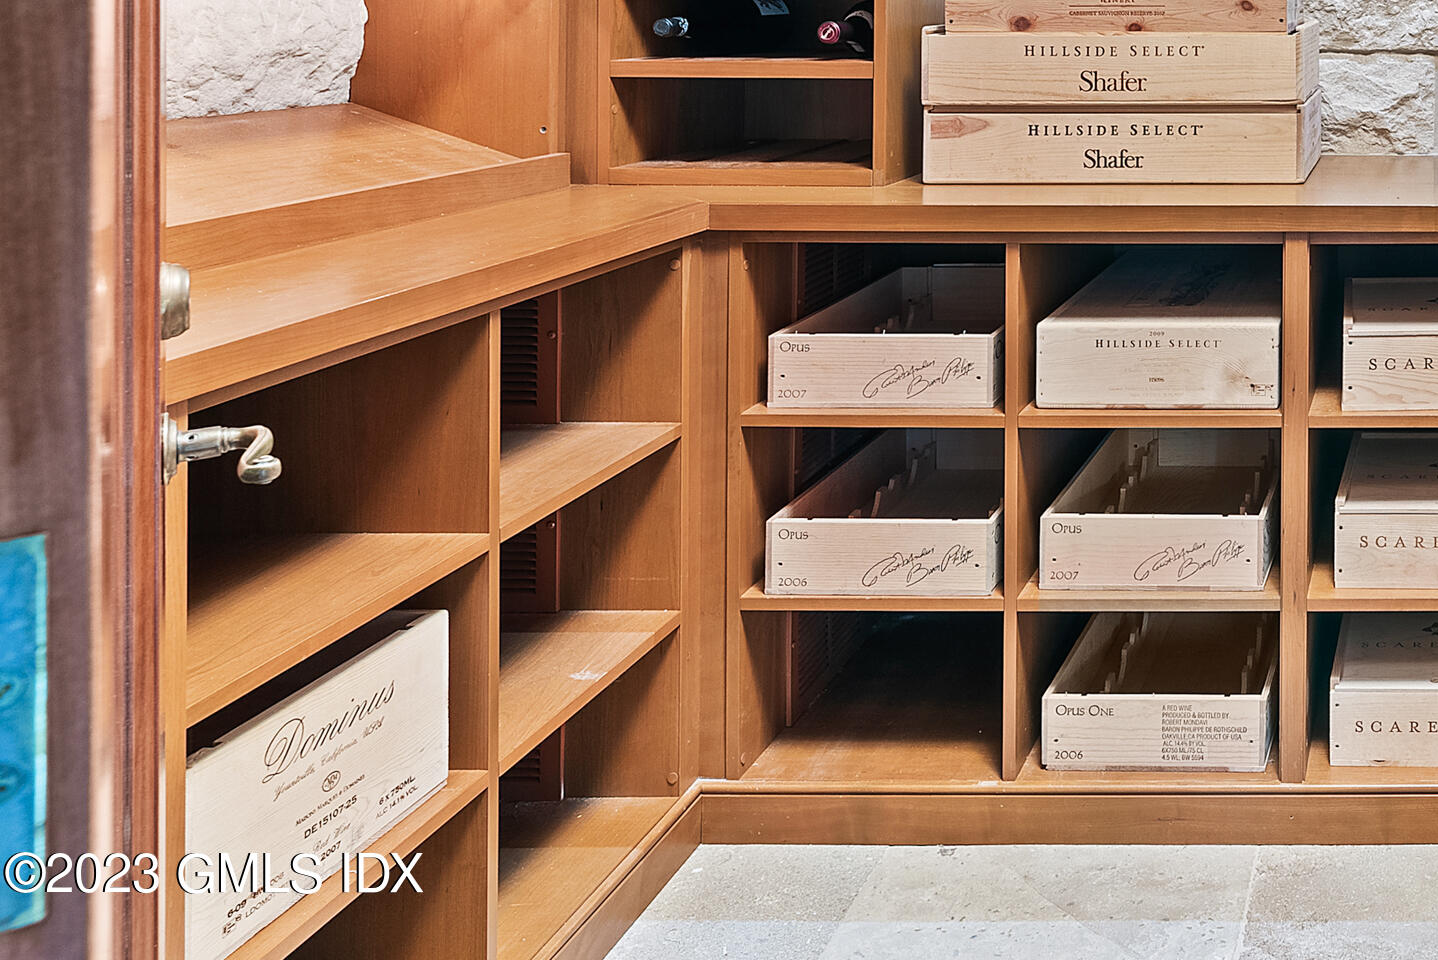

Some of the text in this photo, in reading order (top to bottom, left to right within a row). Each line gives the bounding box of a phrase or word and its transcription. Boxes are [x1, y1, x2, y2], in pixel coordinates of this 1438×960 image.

[1024, 45, 1118, 57] HILLSIDE
[1027, 124, 1119, 136] HILLSIDE
[1095, 339, 1161, 348] HILLSIDE
[777, 389, 807, 399] 2007
[1049, 571, 1079, 580] 2007
[778, 577, 808, 587] 2006
[262, 679, 395, 784] Dominus
[1054, 750, 1084, 760] 2006
[303, 794, 358, 839] DE15107-25
[320, 840, 342, 862] 2007
